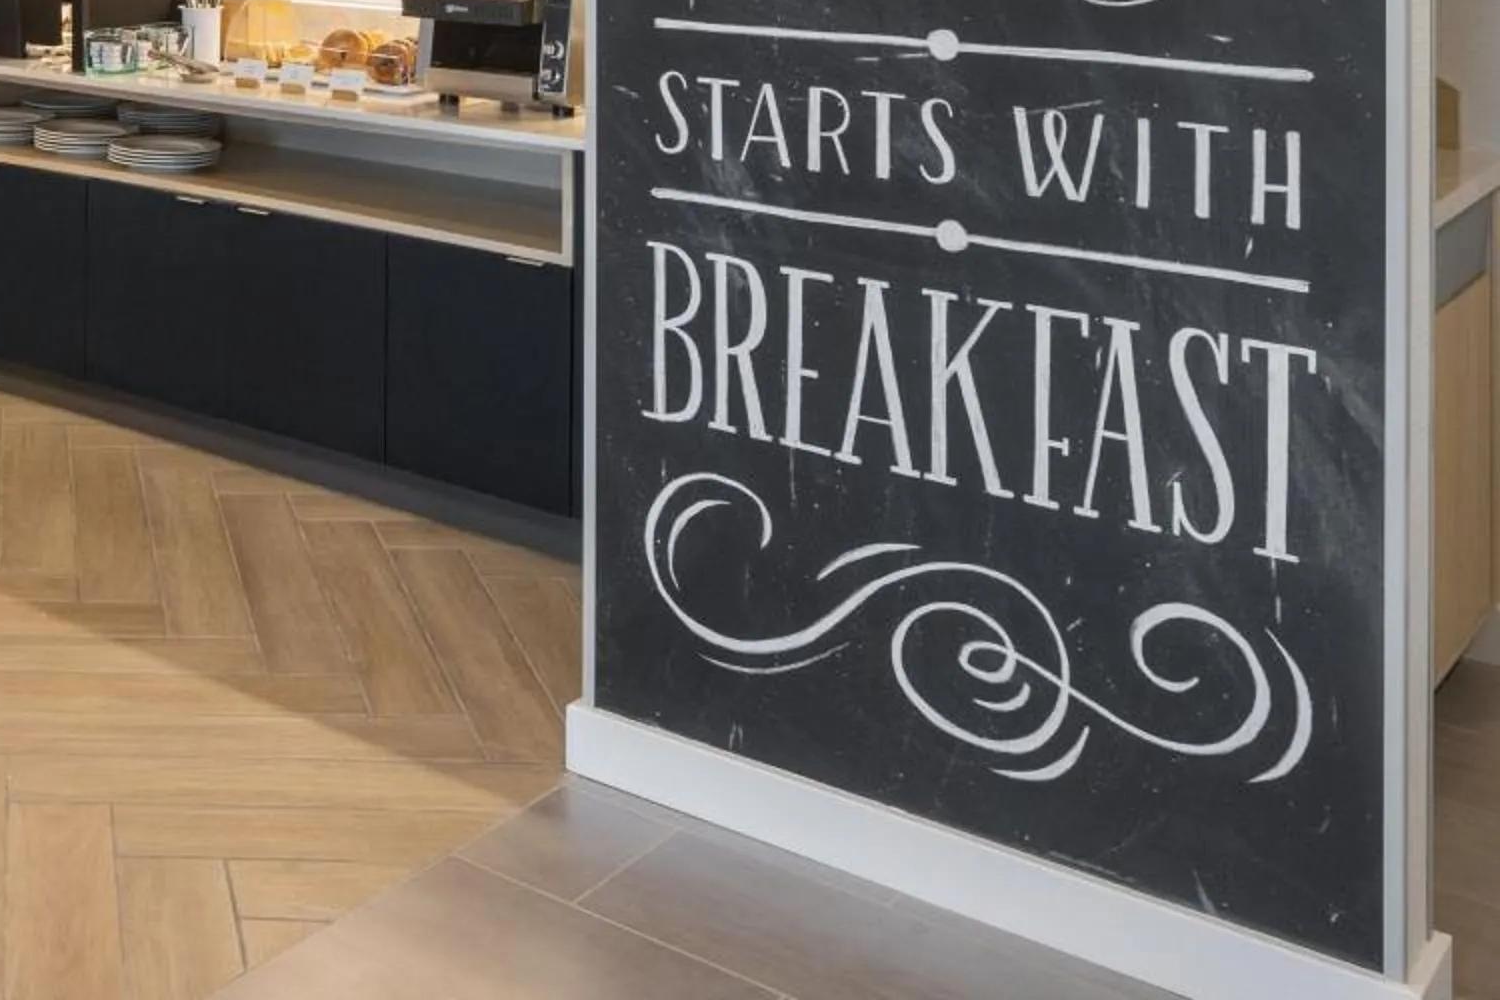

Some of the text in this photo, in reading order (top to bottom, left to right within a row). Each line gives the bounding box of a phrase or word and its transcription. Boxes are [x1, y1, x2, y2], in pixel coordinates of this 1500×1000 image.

[655, 70, 1301, 229] STARTS WITH
[642, 241, 1317, 562] BREAKFAST
